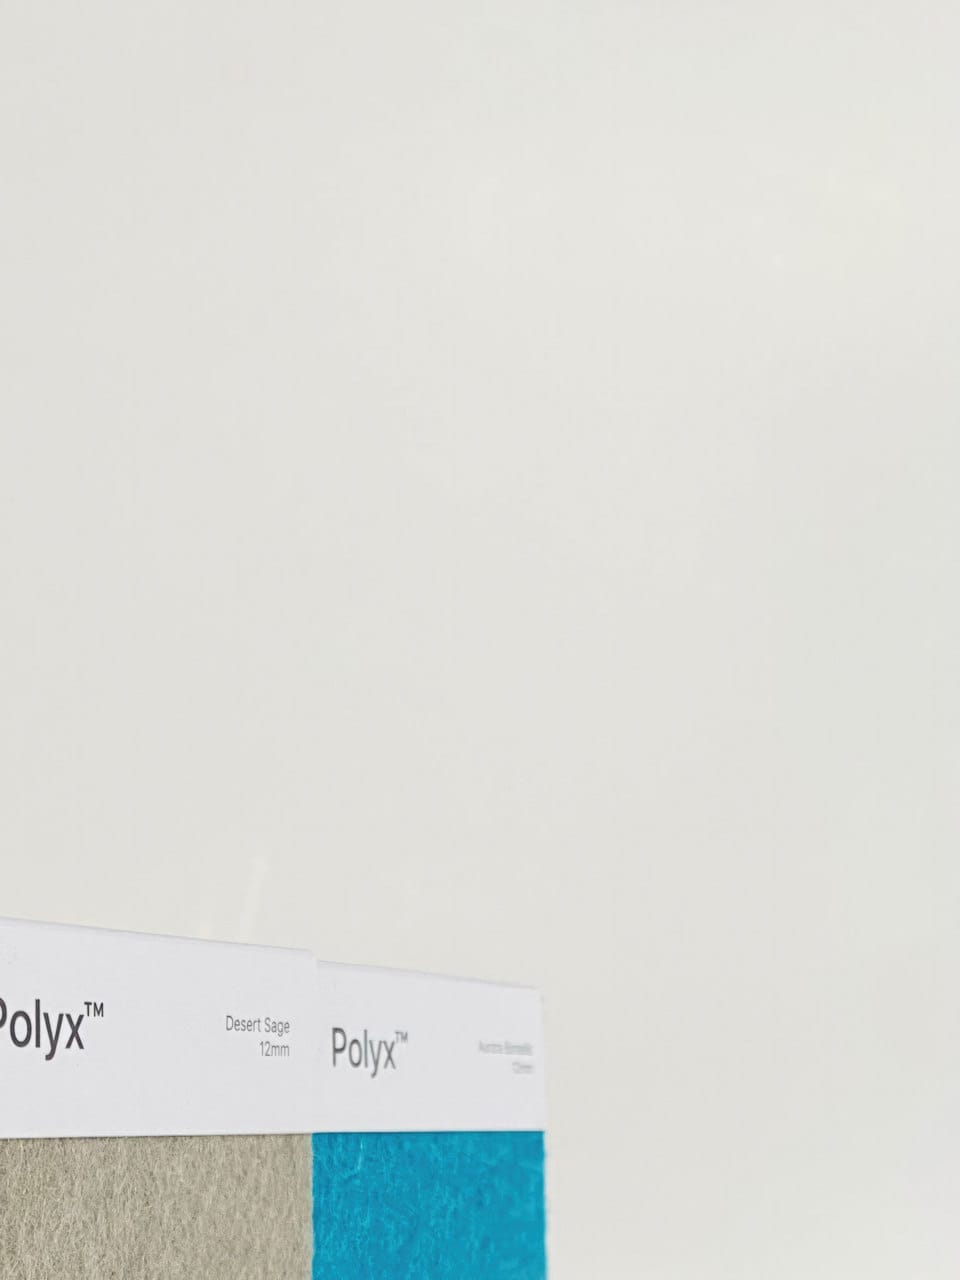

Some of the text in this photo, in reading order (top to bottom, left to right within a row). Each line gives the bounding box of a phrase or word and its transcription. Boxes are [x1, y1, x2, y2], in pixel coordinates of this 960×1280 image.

[226, 1015, 290, 1037] Desert Sage
[259, 1040, 290, 1057] 12mm
